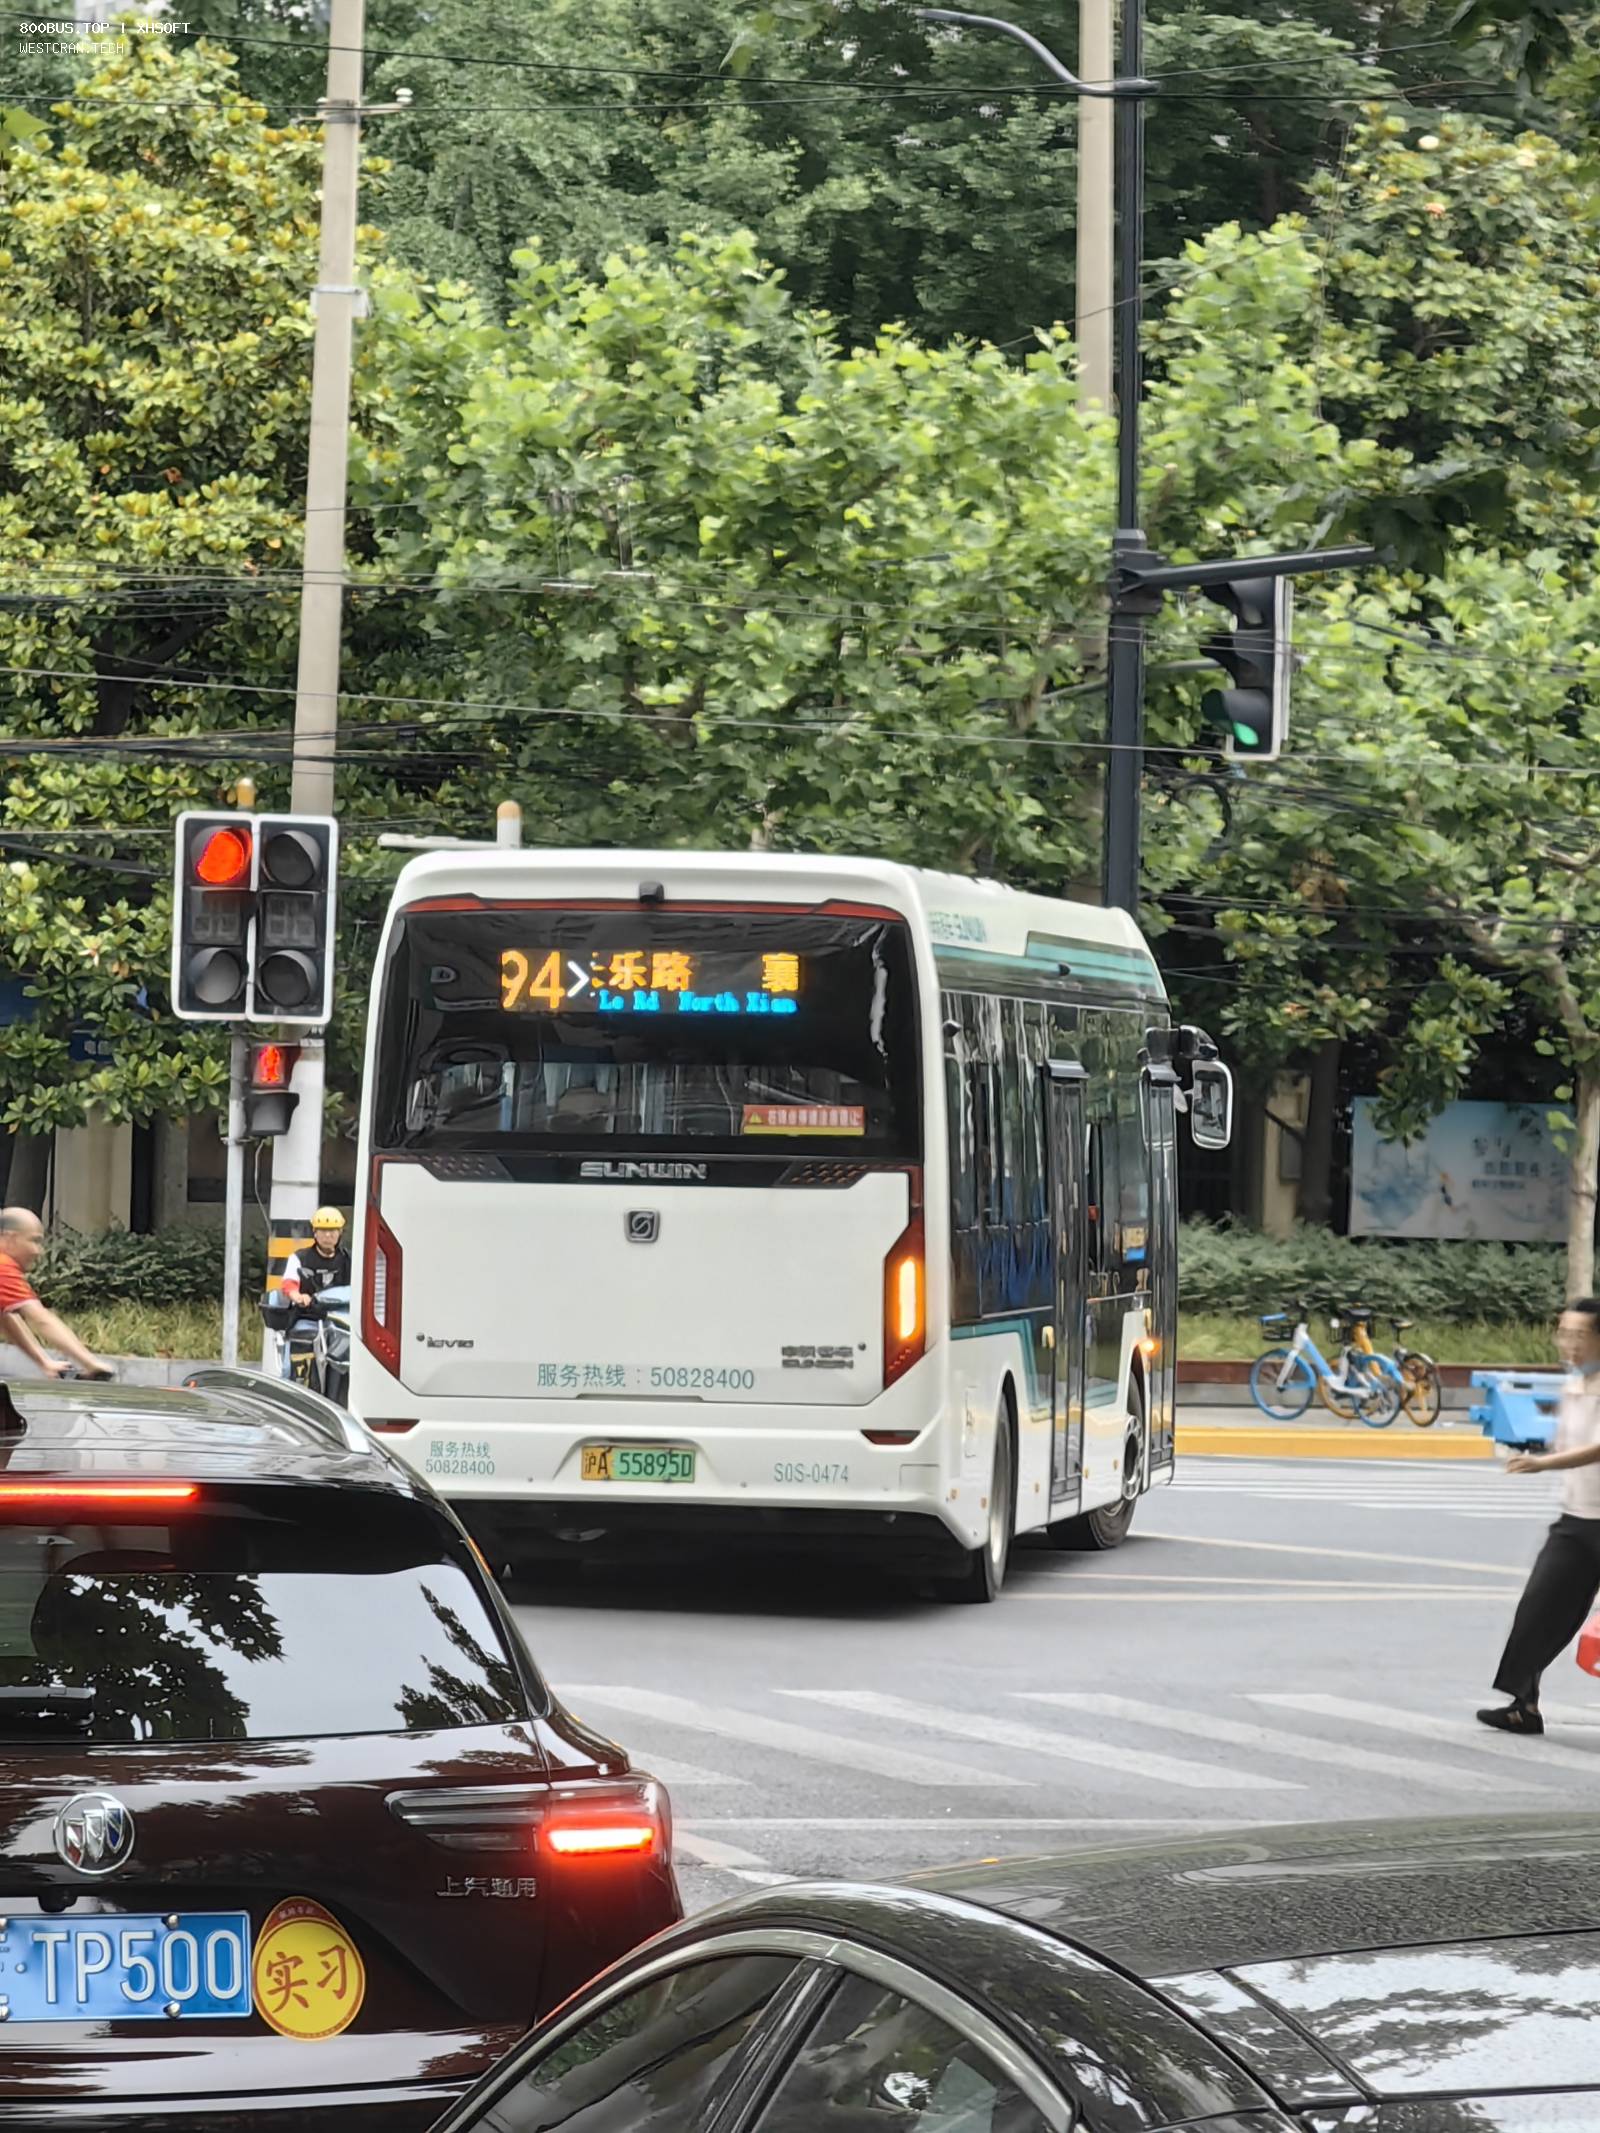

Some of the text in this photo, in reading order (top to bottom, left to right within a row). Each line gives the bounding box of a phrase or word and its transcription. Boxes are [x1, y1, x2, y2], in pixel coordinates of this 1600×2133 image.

[580, 1161, 707, 1179] SUNWIN
[430, 1441, 491, 1459] 服务热线
[425, 1459, 495, 1476] 50828400
[436, 1876, 536, 1898] 上汽通用
[0, 1930, 242, 2004] ·TP500
[265, 1944, 347, 2014] 实习
